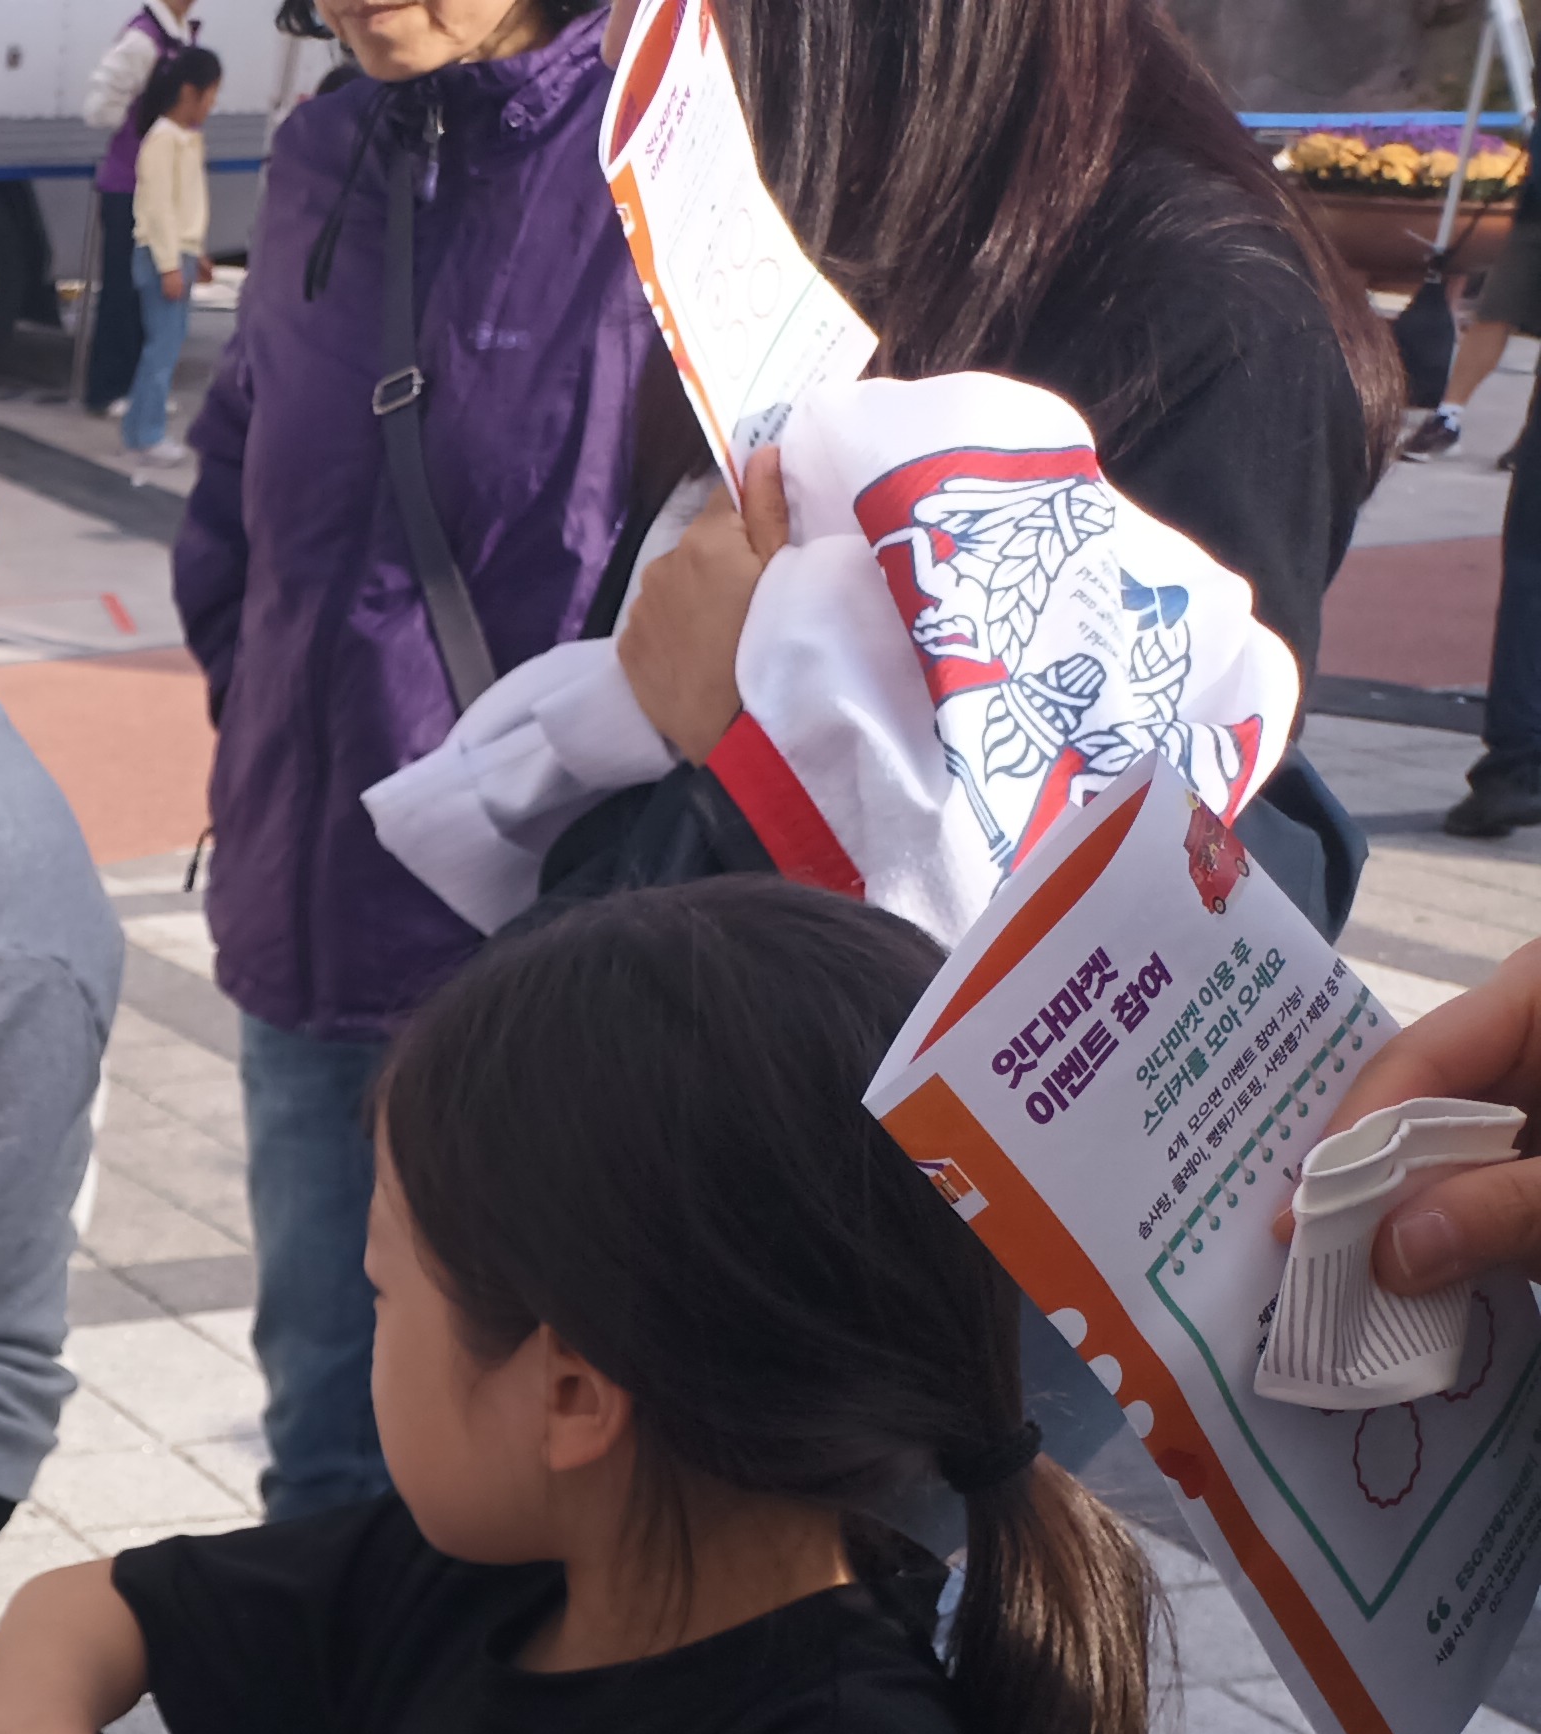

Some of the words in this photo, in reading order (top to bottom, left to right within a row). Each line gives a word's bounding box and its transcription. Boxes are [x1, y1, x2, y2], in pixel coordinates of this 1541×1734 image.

[991, 945, 1119, 1090] 잇다마켓
[1025, 1018, 1120, 1125] 이벤트
[1110, 950, 1174, 1035] 참여
[1136, 998, 1205, 1091] 잇다마켓
[1198, 960, 1236, 1007] 이용
[1229, 936, 1253, 968] 후
[1143, 1046, 1210, 1137] 스티커를
[1203, 1004, 1243, 1057] 모아
[1237, 947, 1287, 1016] 오세요
[1167, 1130, 1190, 1162] 4개
[1187, 1086, 1225, 1136] 모으면
[1221, 1046, 1258, 1091] 이벤트
[1254, 1016, 1282, 1052] 참여
[1276, 985, 1305, 1023] 가능!
[1138, 1191, 1177, 1241] 솜사탕,
[1171, 1145, 1212, 1195] 클레이,
[1264, 1017, 1310, 1078] 사탕뽑기
[1305, 989, 1331, 1025] 체험
[1324, 975, 1340, 997] 중
